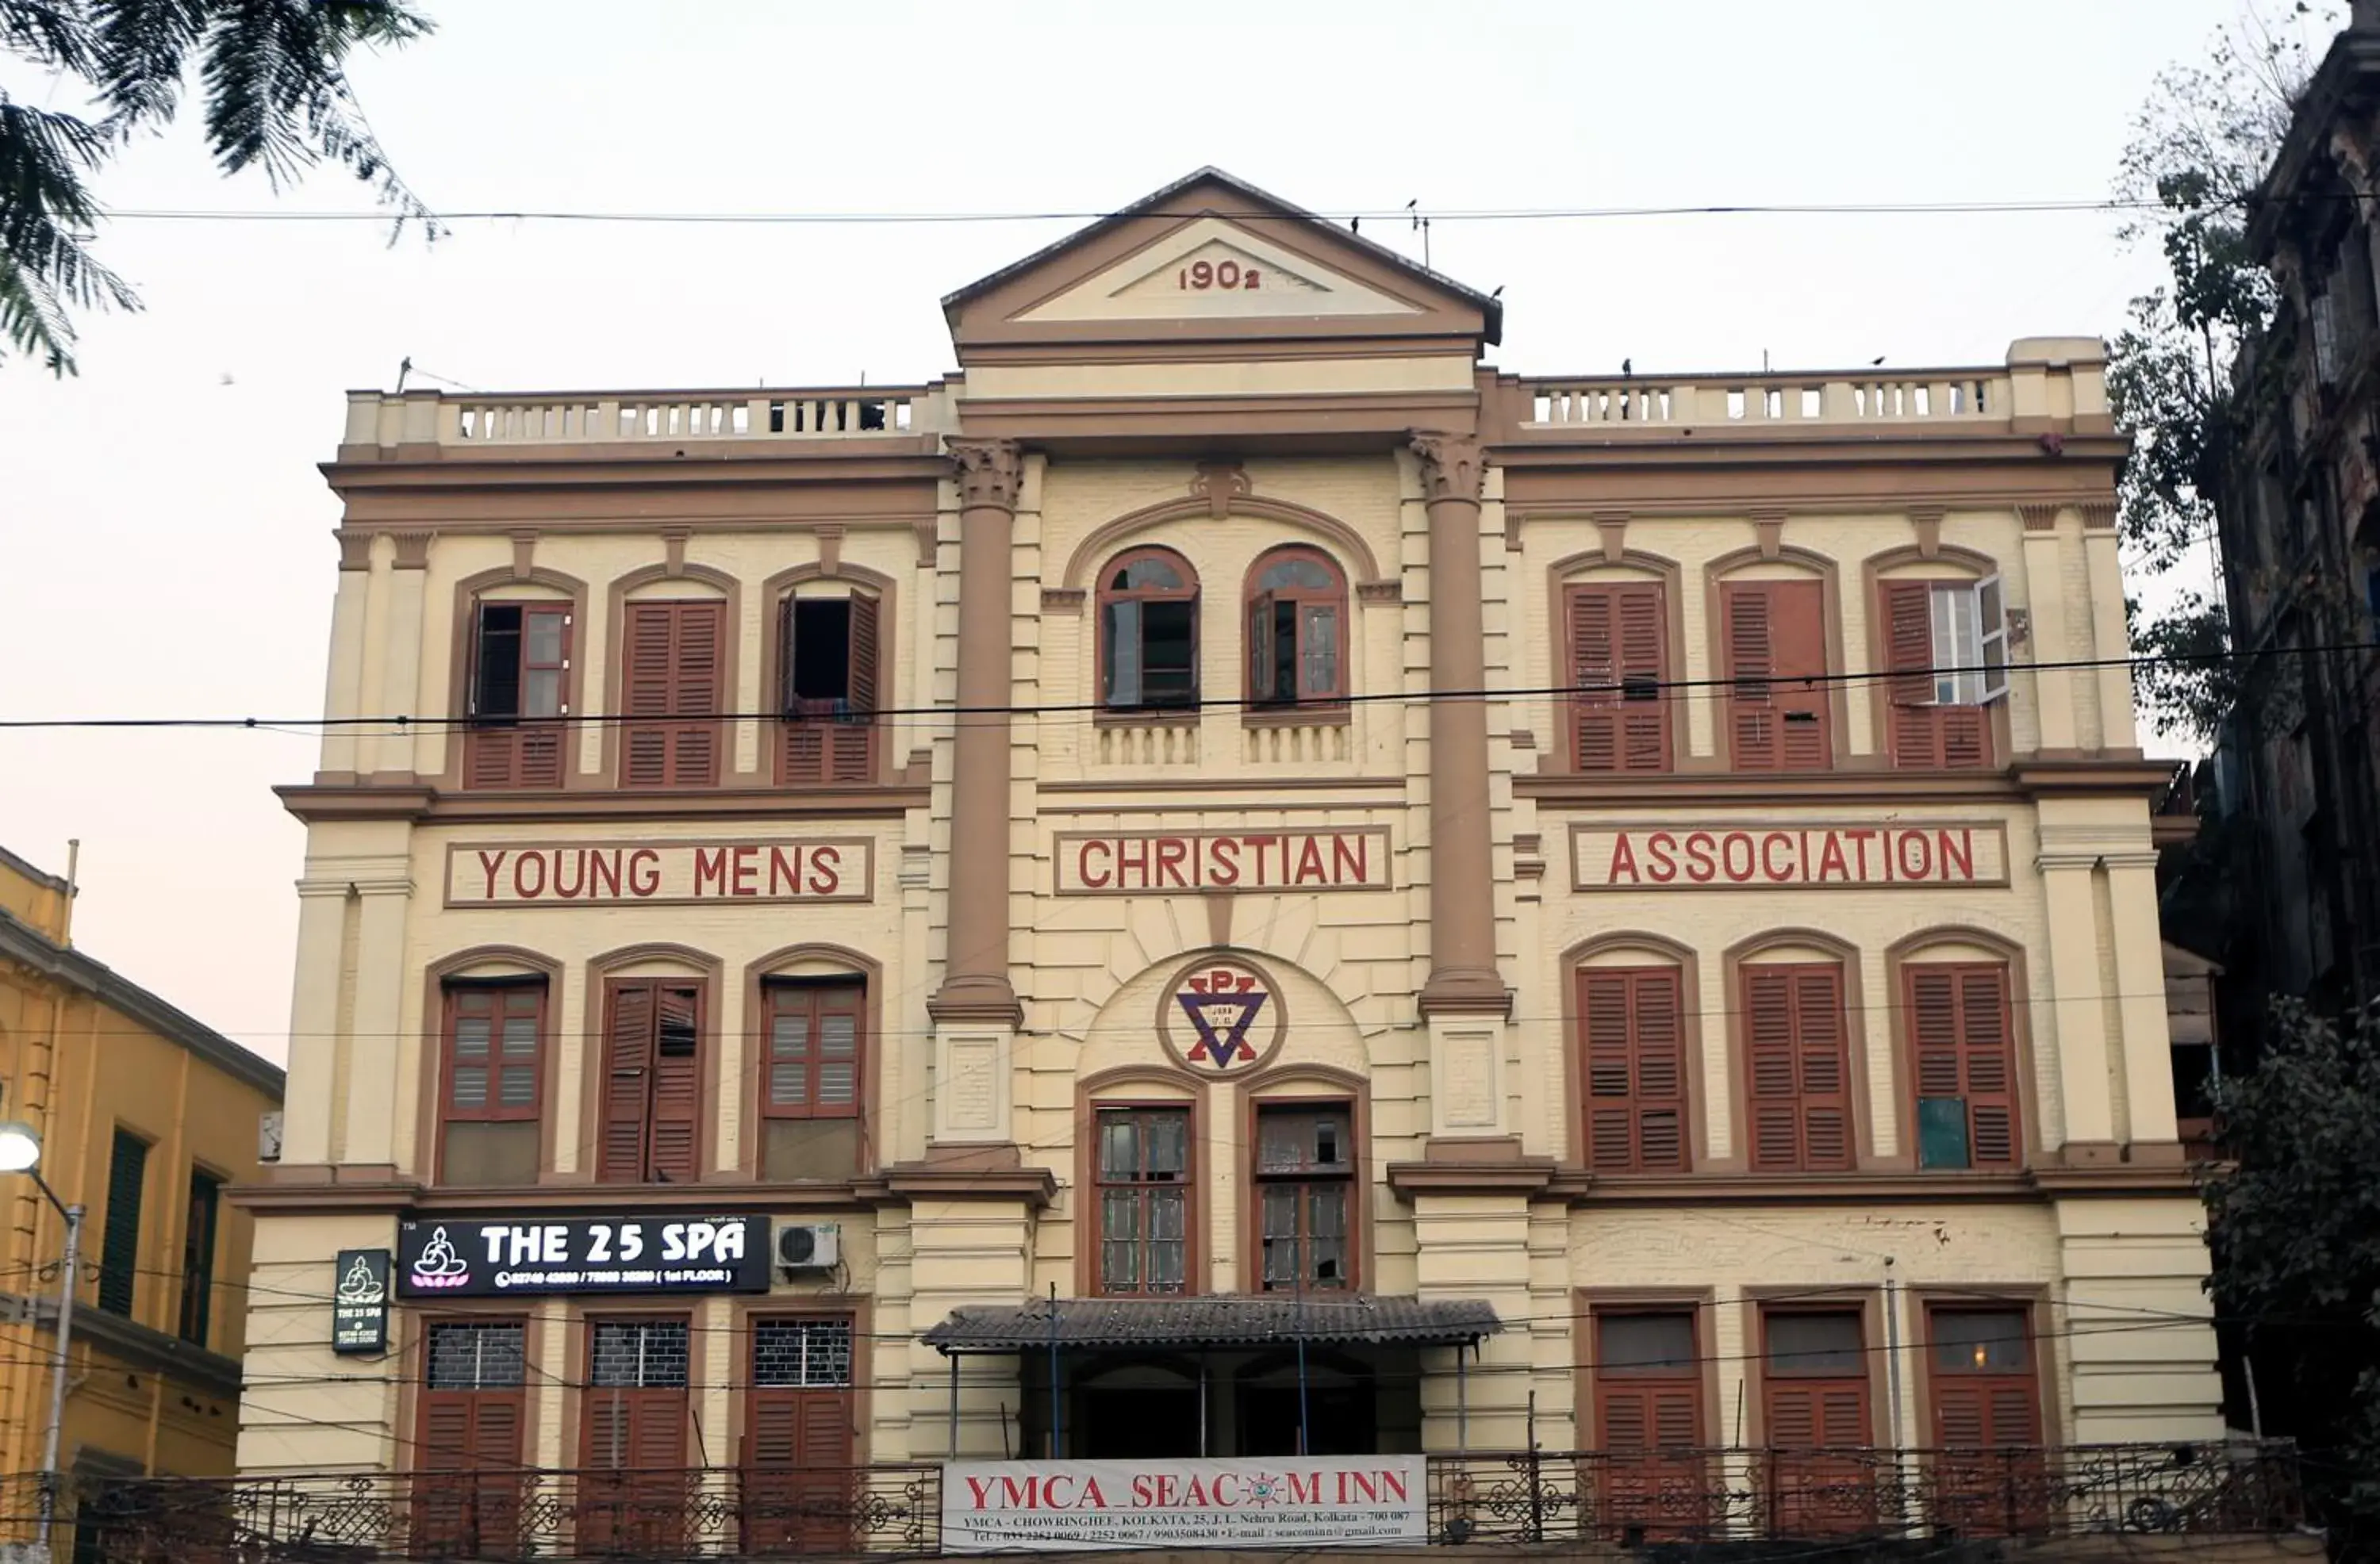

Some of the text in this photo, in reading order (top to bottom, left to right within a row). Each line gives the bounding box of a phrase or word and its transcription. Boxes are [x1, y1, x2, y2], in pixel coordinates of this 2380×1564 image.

[1180, 260, 1260, 290] 1902
[478, 846, 841, 899] YOUNG MENS
[1079, 834, 1366, 888] CHRISTIAN
[1608, 829, 1975, 884] ASSOCIATION
[481, 1223, 746, 1266] THE 25 SPA
[683, 1270, 724, 1282] FLOOR
[965, 1474, 1107, 1509] YMCA
[1335, 1470, 1409, 1505] INN
[964, 1517, 1002, 1528] YMCA
[1240, 1513, 1275, 1524] Nehru
[1315, 1511, 1358, 1523] Kolkata
[1368, 1511, 1387, 1521] 700
[1390, 1511, 1411, 1521] 087
